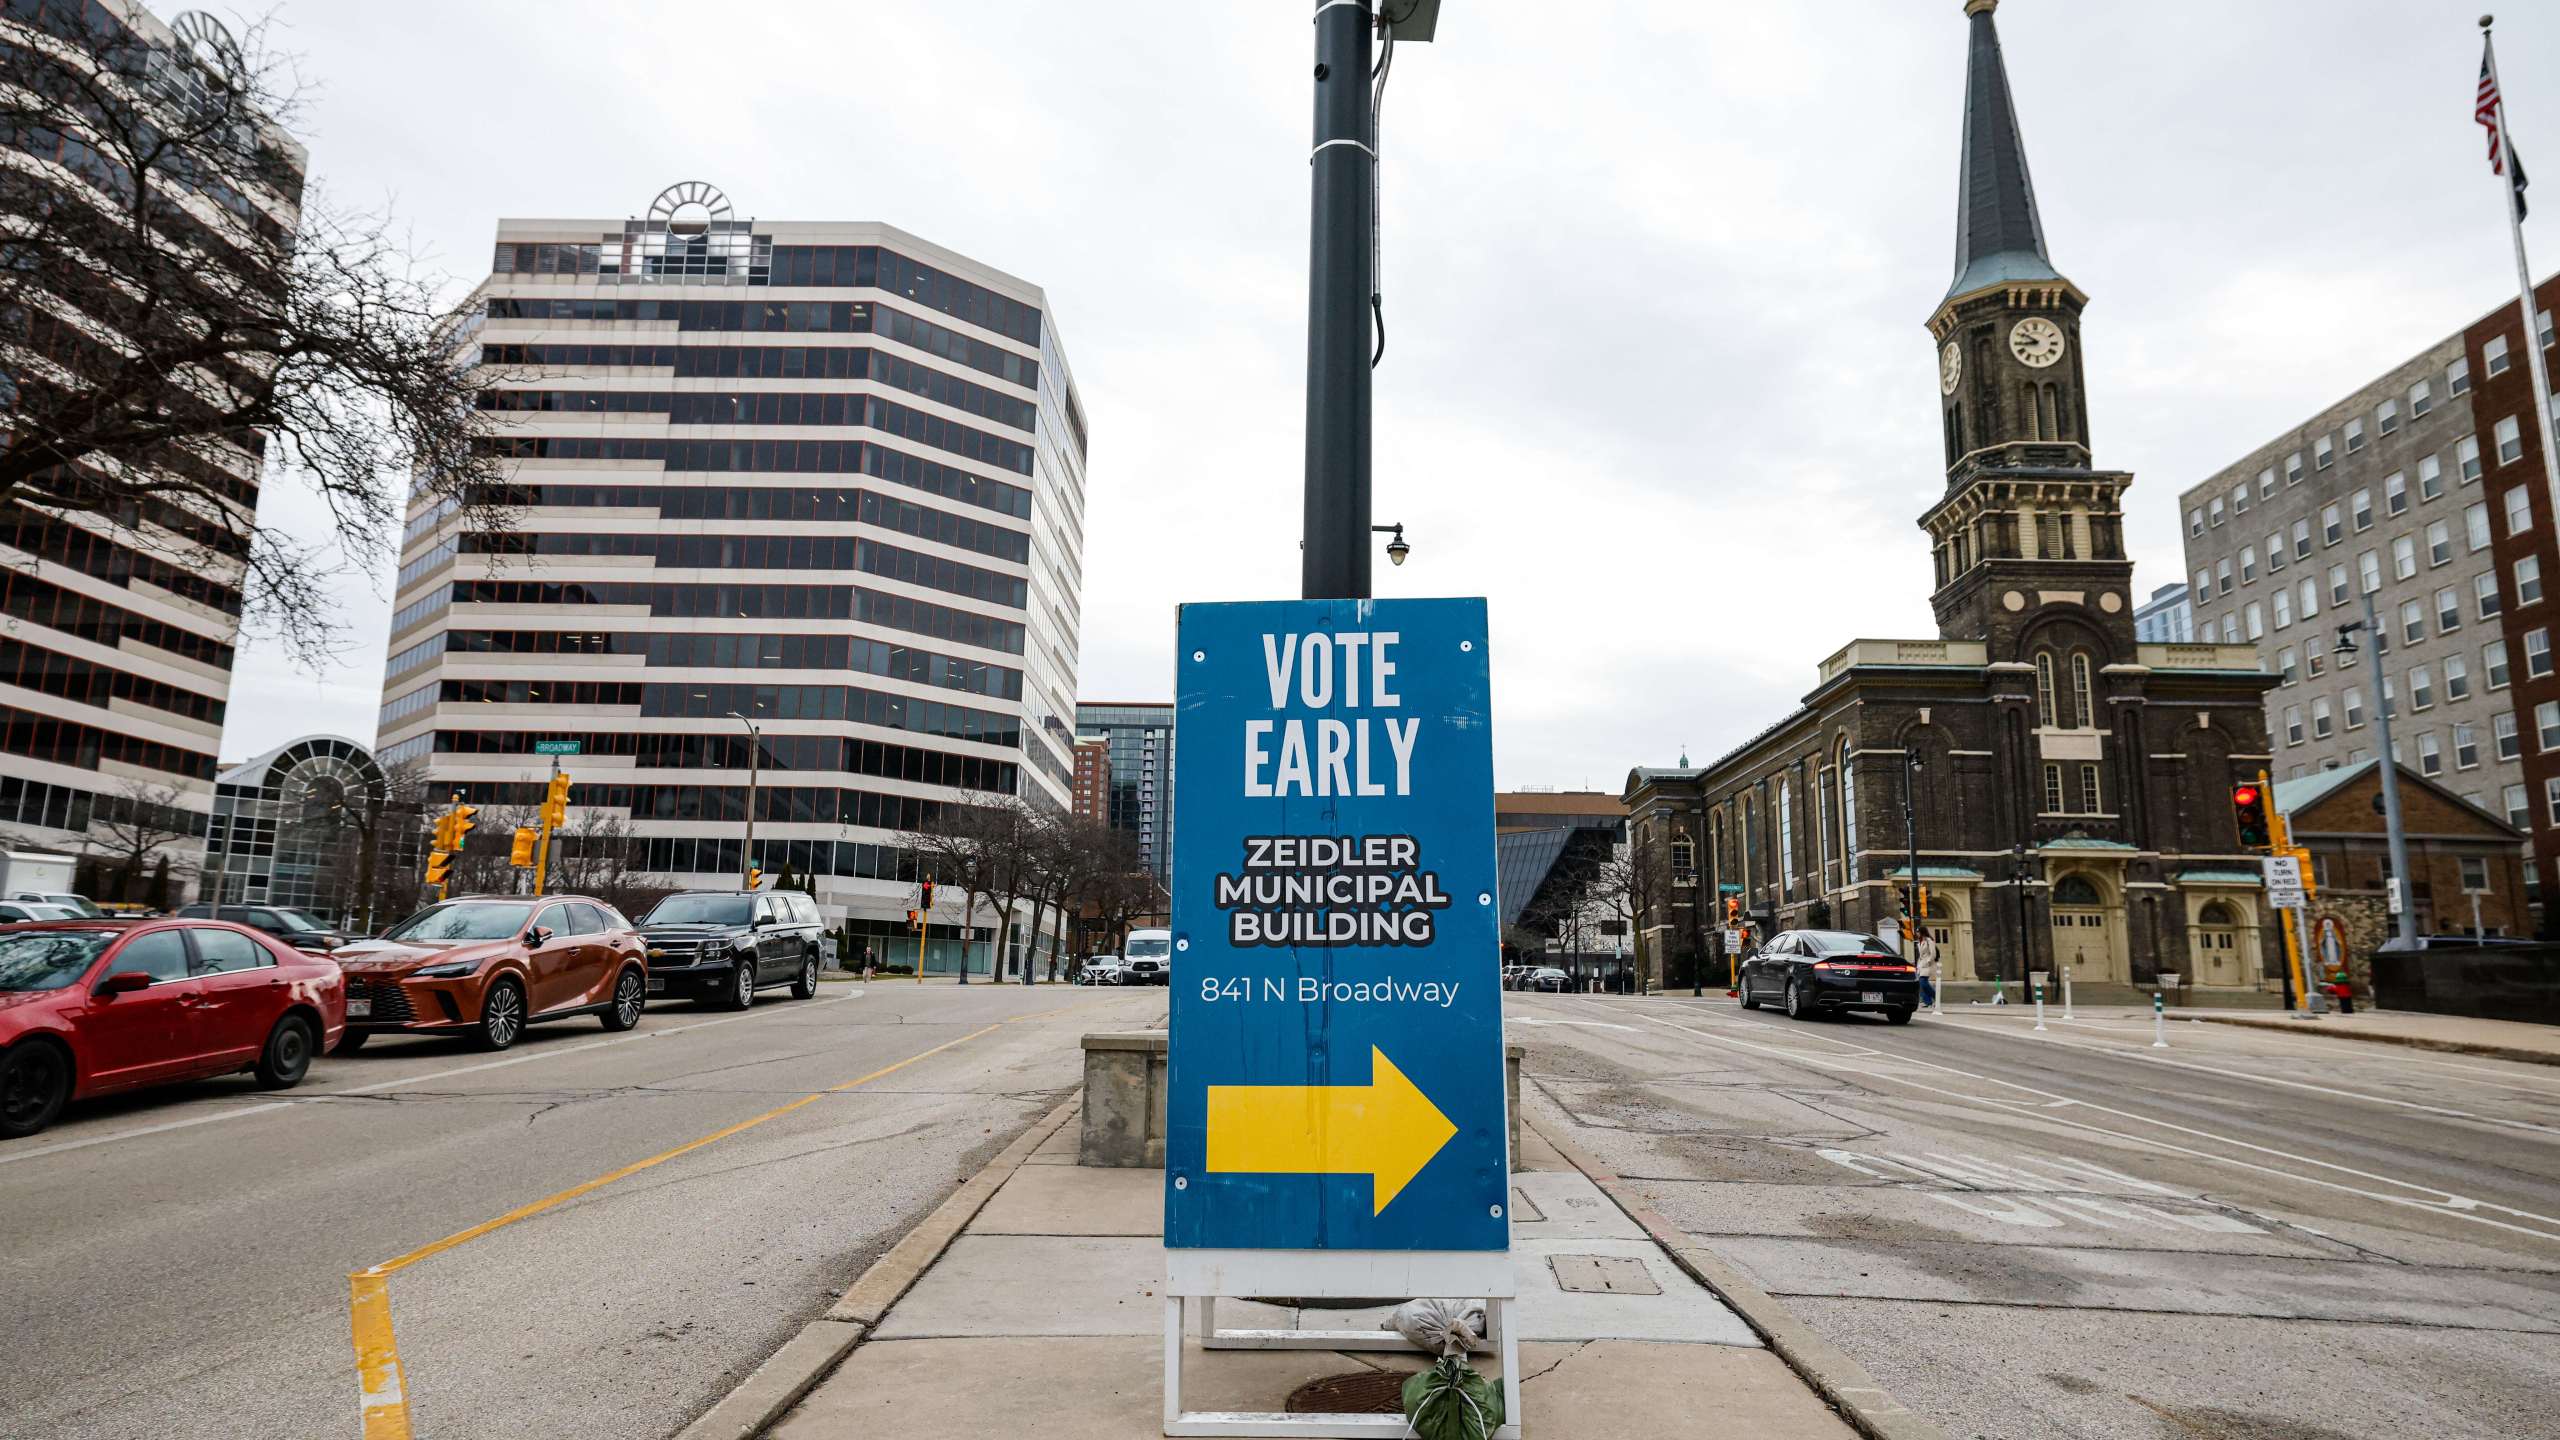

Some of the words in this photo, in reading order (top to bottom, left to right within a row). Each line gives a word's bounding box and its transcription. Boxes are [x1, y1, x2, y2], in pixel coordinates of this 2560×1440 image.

[1263, 632, 1400, 709] VOTE
[540, 743, 577, 752] BROADWAY
[1245, 718, 1420, 797] EARLY
[1248, 839, 1415, 866] ZEIDLER
[1220, 875, 1446, 904] MUNICIPAL
[1235, 912, 1429, 942] BUILDING
[1202, 978, 1250, 1001] 841
[1265, 978, 1284, 1001] N
[1299, 976, 1459, 1007] Broadway
